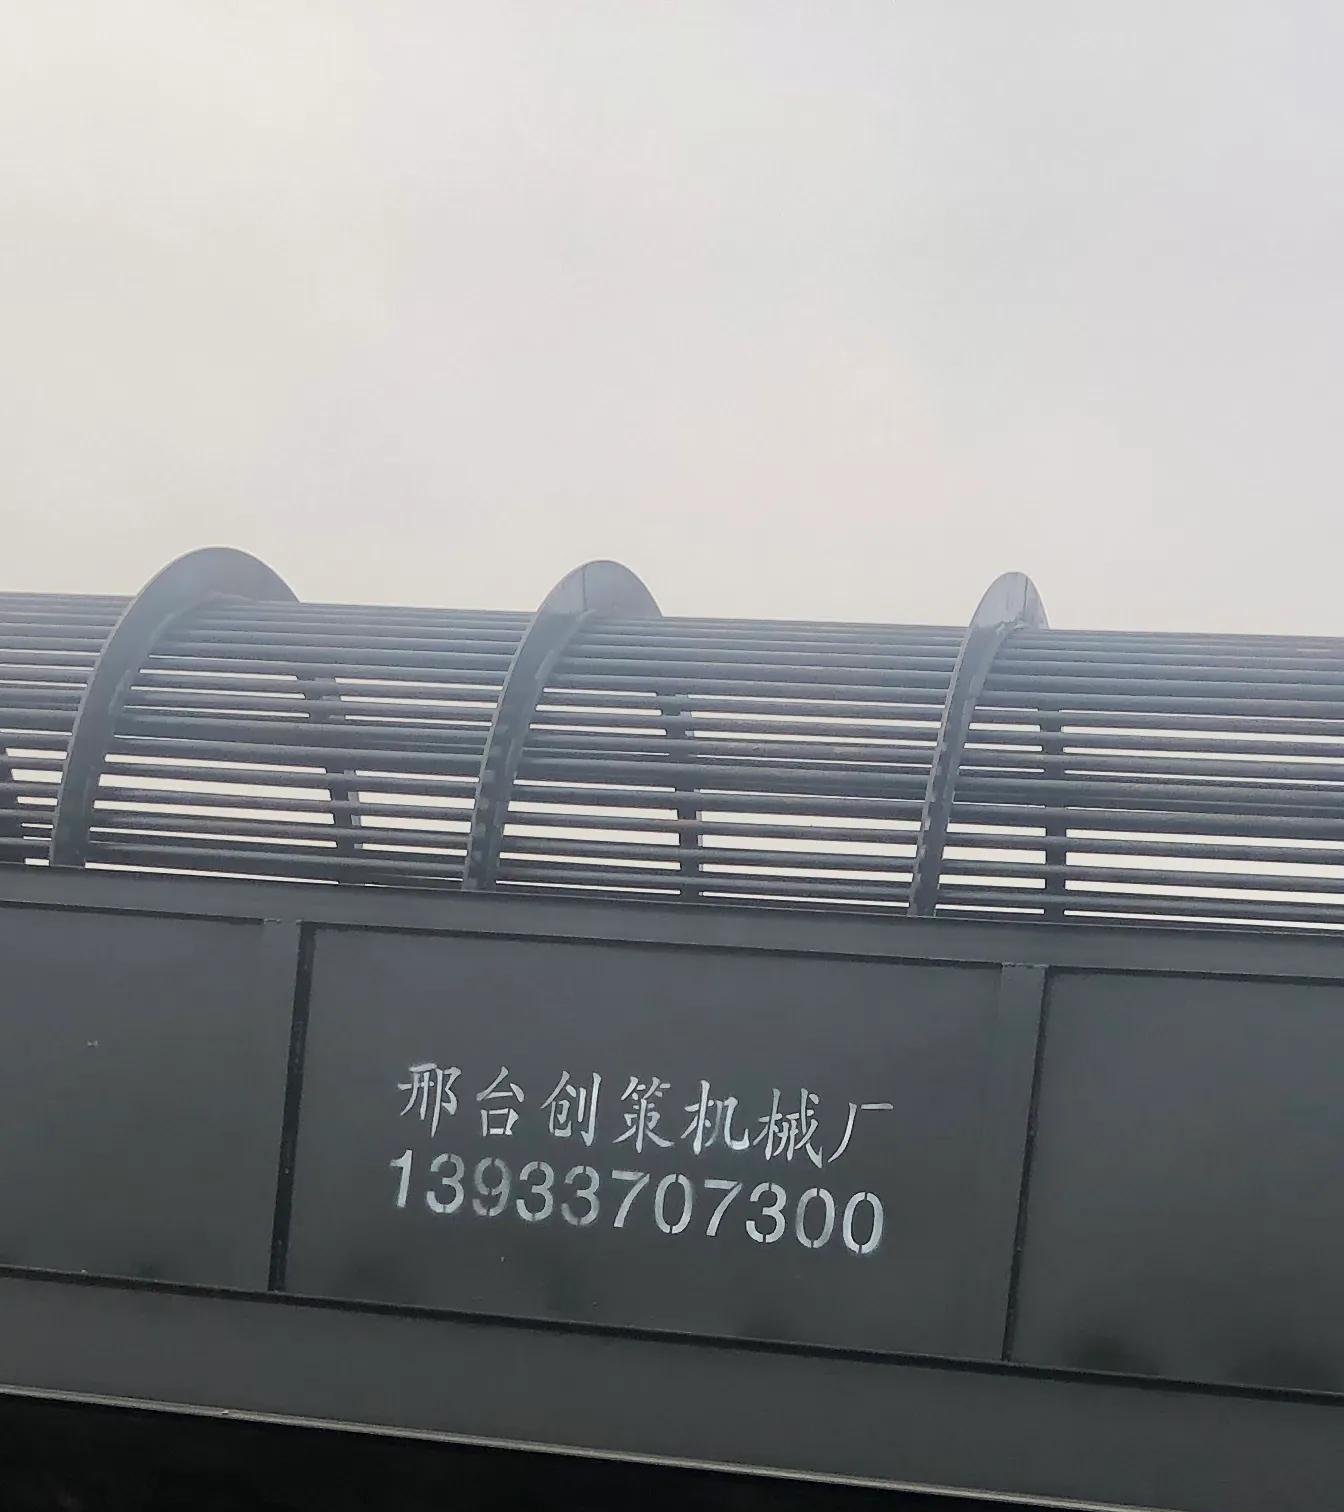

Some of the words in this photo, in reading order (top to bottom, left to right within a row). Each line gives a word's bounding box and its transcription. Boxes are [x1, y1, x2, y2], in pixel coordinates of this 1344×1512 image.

[397, 1062, 894, 1169] 邢台创策机械厂
[389, 1149, 885, 1254] 13933707300
